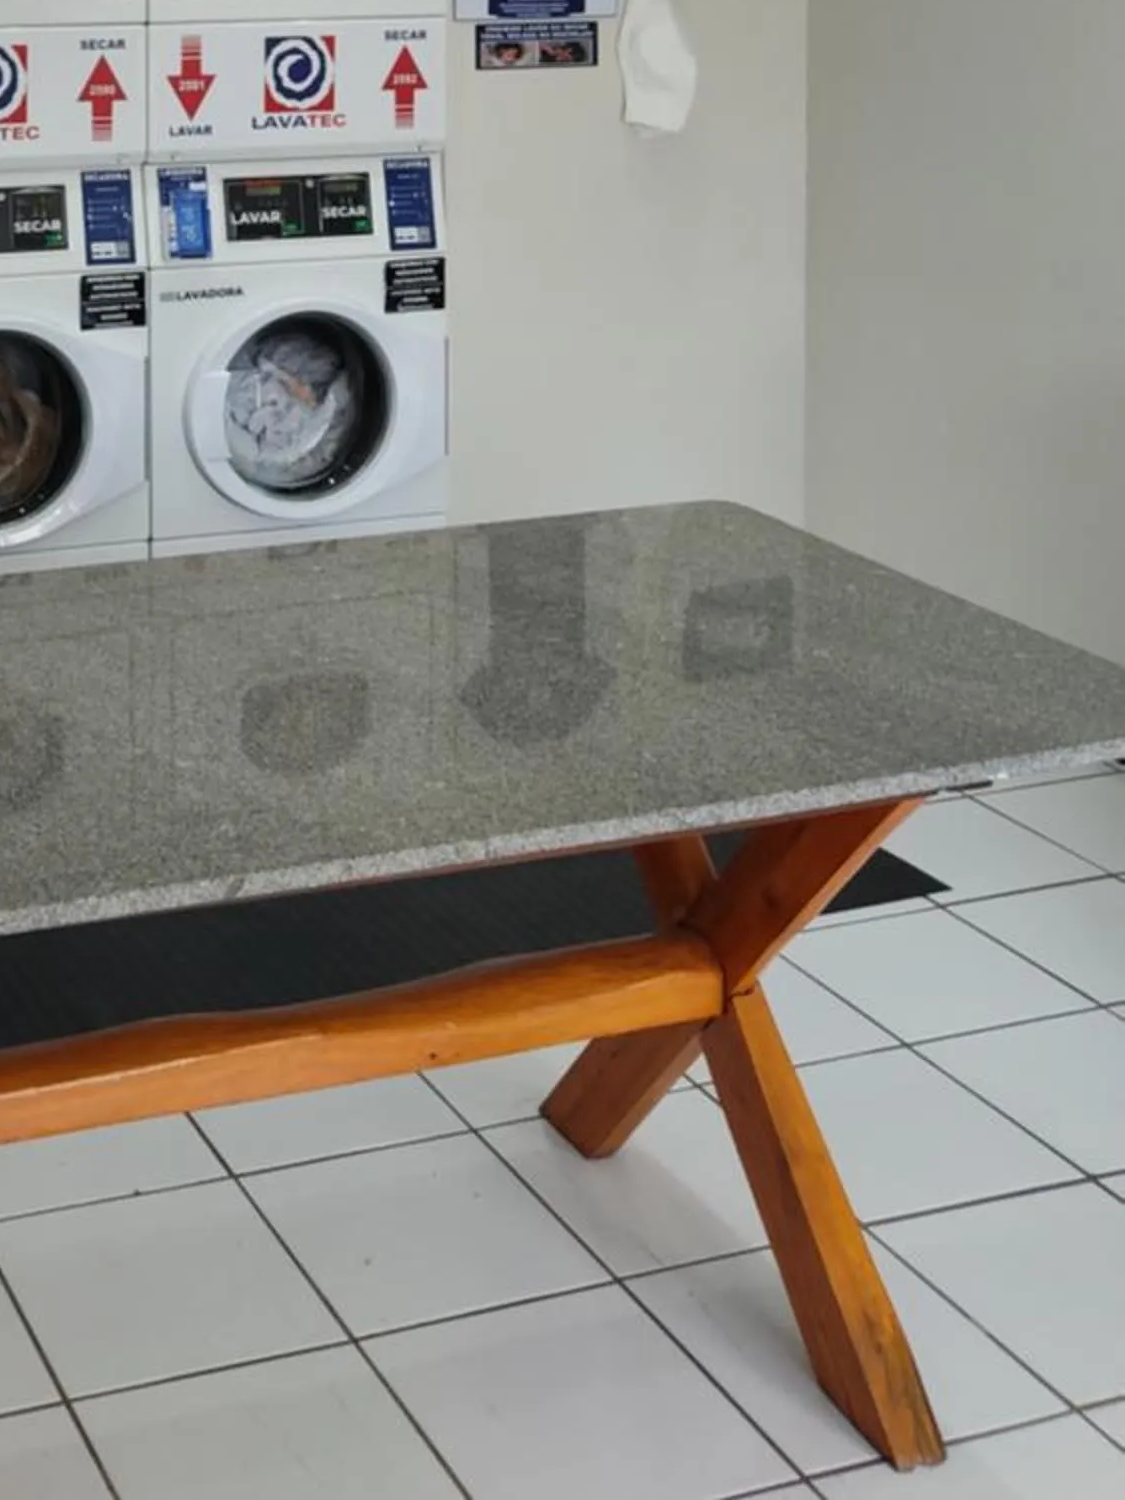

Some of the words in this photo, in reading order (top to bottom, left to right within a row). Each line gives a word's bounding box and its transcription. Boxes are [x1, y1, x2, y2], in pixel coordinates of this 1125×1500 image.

[384, 30, 427, 41] SECAR
[80, 39, 126, 50] SECAR
[252, 114, 347, 130] LAVATEC
[169, 125, 213, 137] LAVAR
[230, 211, 281, 225] LAVAR
[321, 206, 367, 219] SECAR
[13, 219, 62, 233] SECAR
[176, 286, 243, 301] LAVADORA
